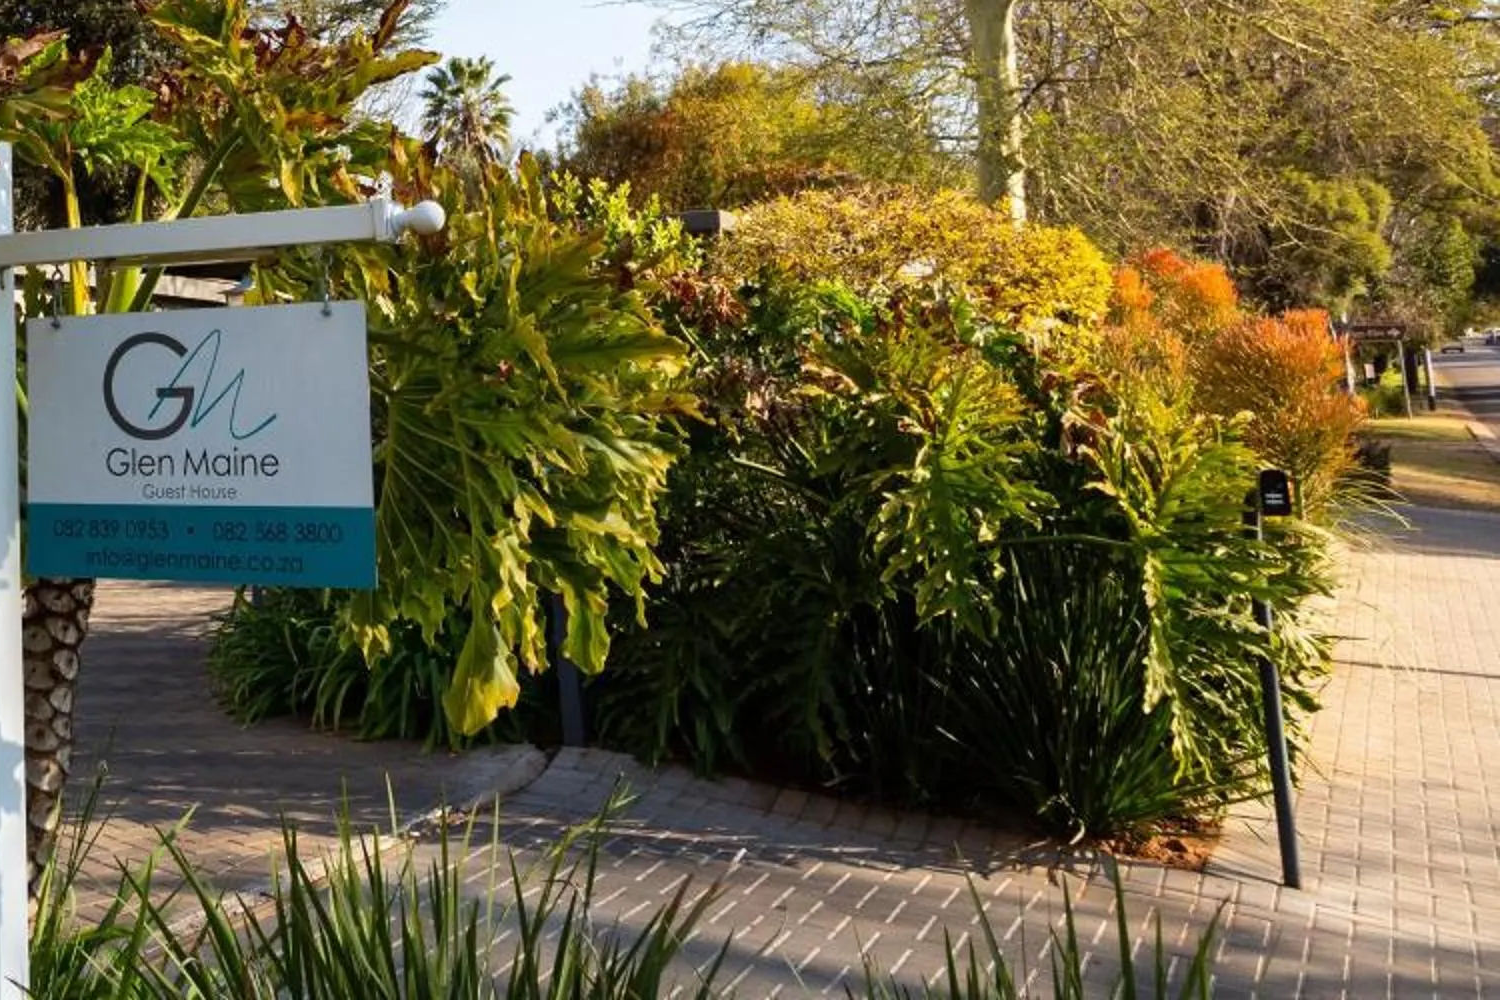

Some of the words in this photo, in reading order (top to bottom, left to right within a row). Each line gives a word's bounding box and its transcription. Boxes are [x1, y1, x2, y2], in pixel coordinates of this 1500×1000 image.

[106, 447, 175, 477] Glen
[182, 446, 279, 477] Maine
[142, 483, 186, 500] Guest
[190, 484, 238, 500] House
[53, 519, 84, 538] 082
[89, 519, 120, 539] 839
[124, 519, 170, 540] 0953
[211, 520, 248, 541] 082
[255, 520, 288, 542] 568
[293, 522, 343, 544] 3800
[86, 547, 305, 573] info@glenmaine.co.za
